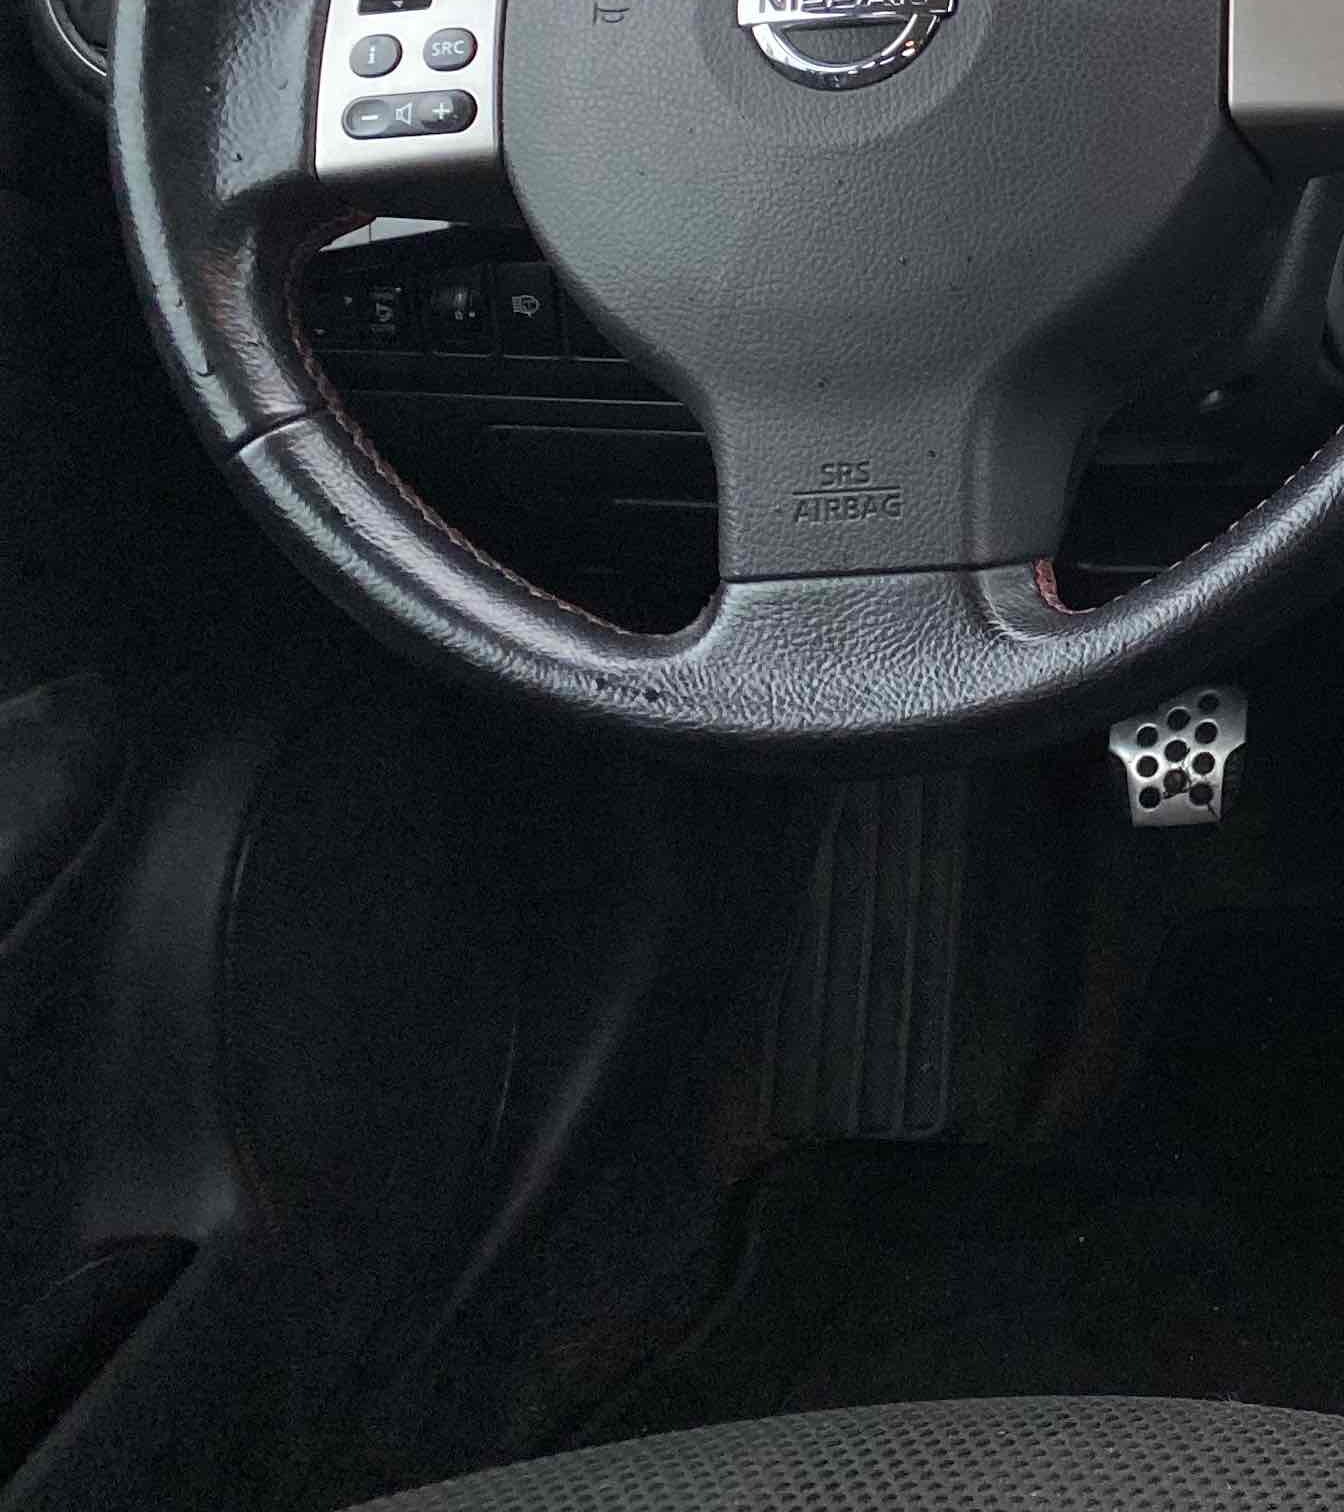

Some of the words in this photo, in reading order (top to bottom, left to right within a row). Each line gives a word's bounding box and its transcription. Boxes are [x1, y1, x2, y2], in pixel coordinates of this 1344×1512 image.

[431, 40, 465, 57] SRC
[821, 460, 870, 486] SRS
[794, 494, 902, 522] AIRBAG
